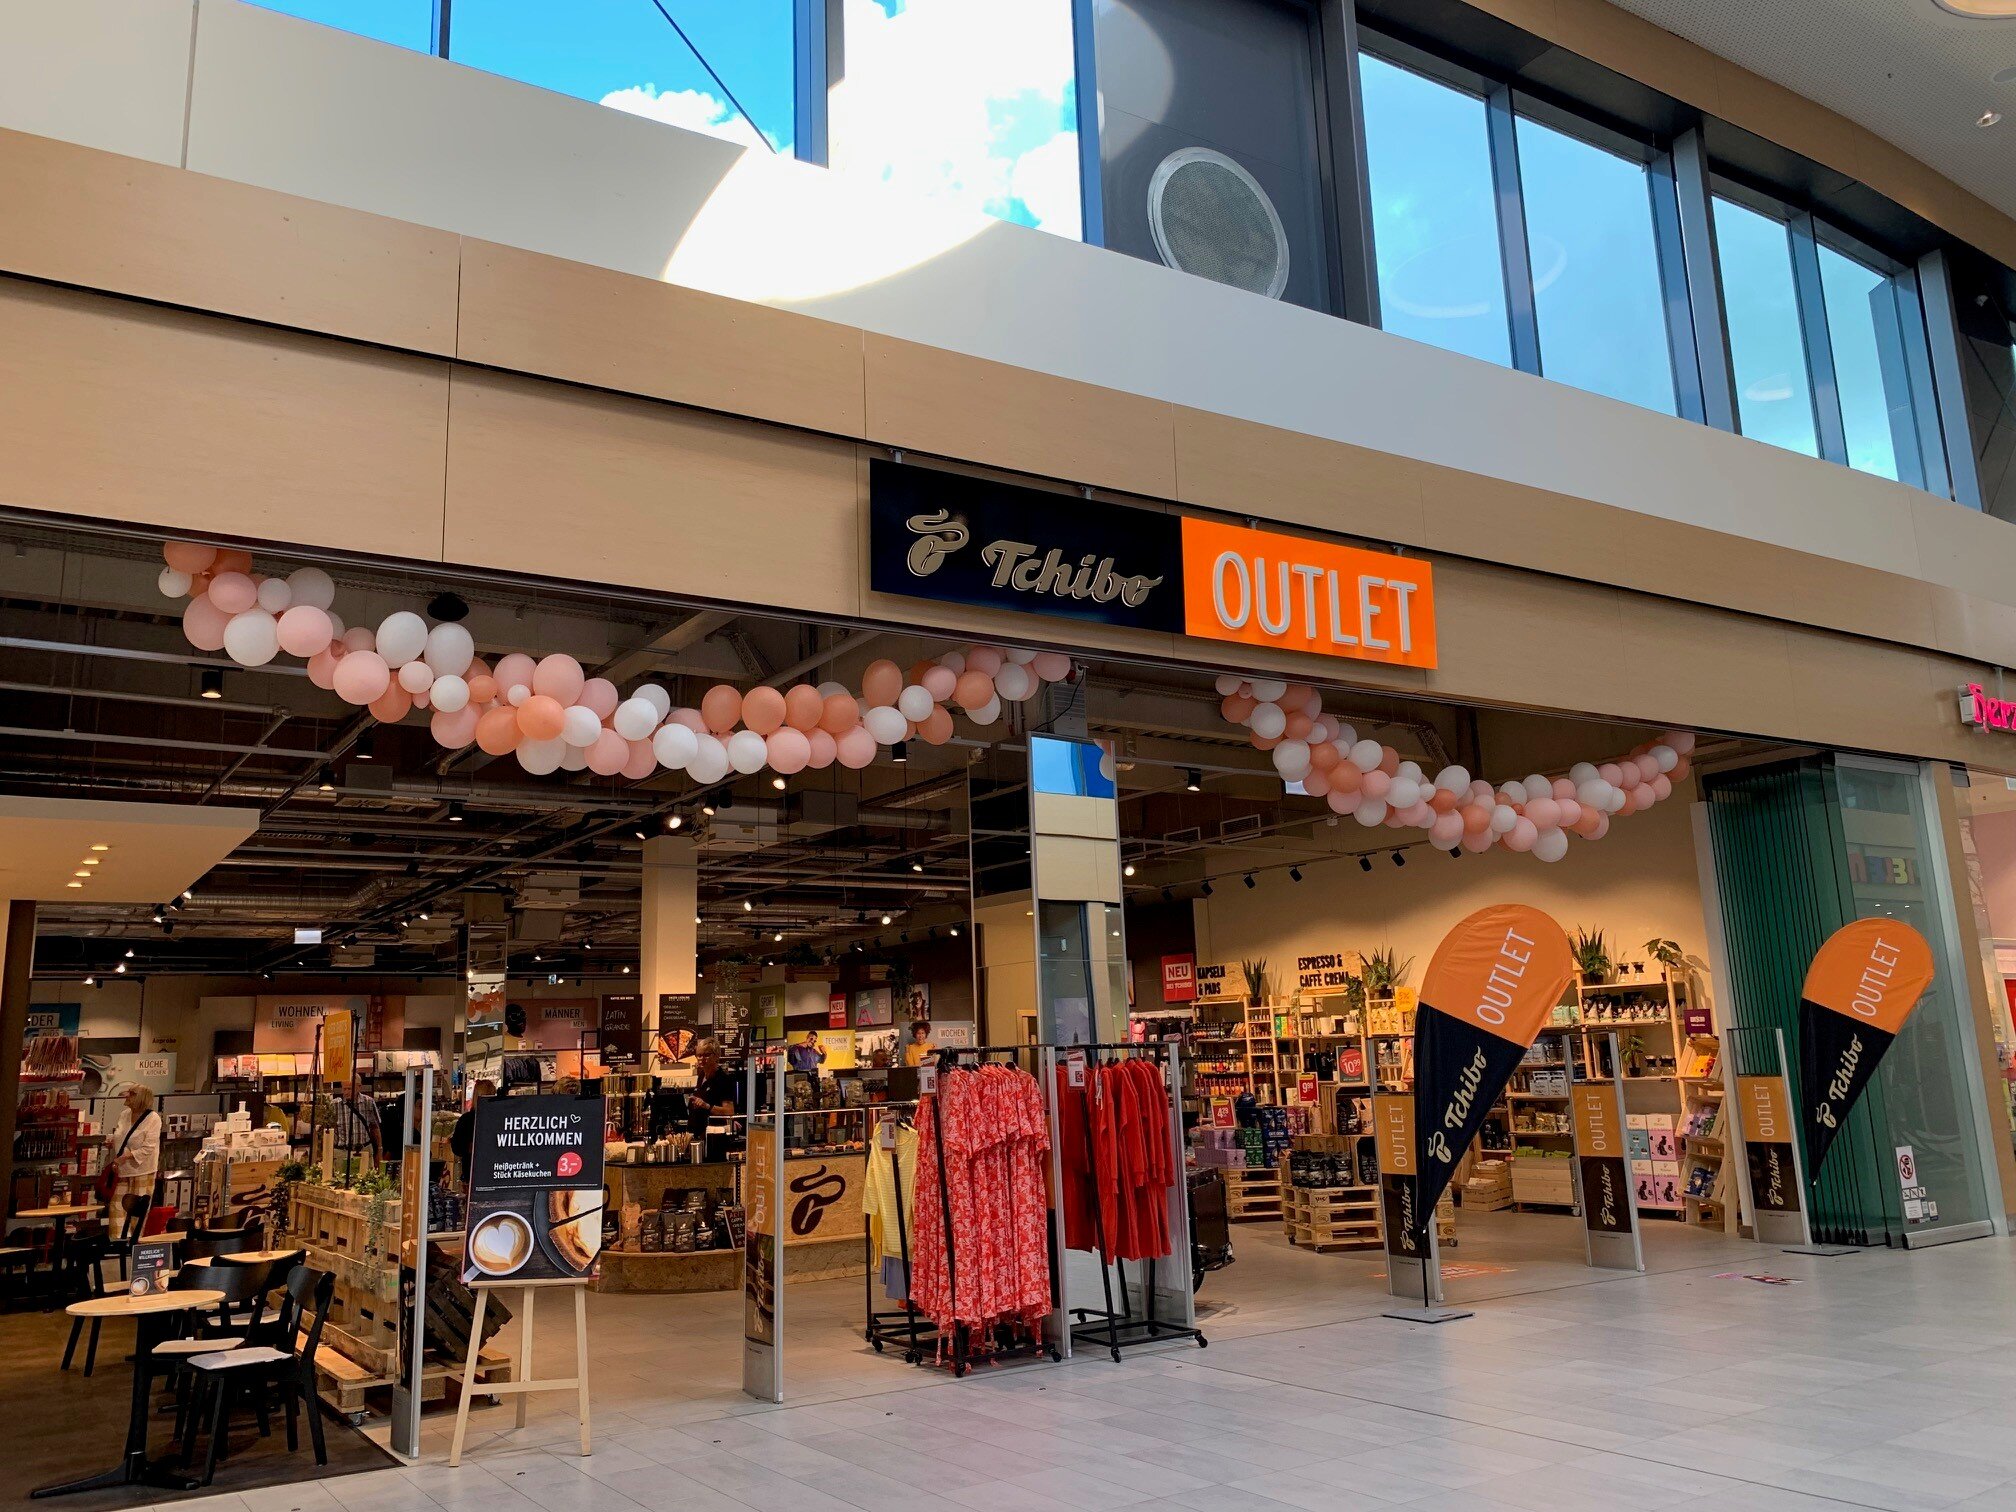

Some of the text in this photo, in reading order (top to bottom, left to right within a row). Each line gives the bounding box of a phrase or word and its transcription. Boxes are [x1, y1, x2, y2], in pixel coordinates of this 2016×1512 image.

[981, 540, 1163, 607] Tchibo
[1212, 550, 1418, 653] OUTLET
[1298, 955, 1335, 970] ESPRESSO
[1168, 966, 1188, 978] NEU
[1197, 965, 1226, 979] KAPSELN
[1300, 970, 1322, 987] CAFFÈ
[1475, 927, 1535, 1025] OUTLET
[1851, 937, 1901, 1017] OUTLET
[1204, 982, 1221, 995] PADS
[279, 1006, 324, 1017] WOHNEN
[544, 1008, 580, 1018] MÄNNER
[272, 1020, 294, 1028] LIVING
[825, 1037, 848, 1045] TECHNIK
[940, 1029, 966, 1038] WOCHEN
[139, 1059, 164, 1068] KÜCHE
[1828, 1033, 1864, 1101] Tchibo
[1444, 1045, 1487, 1128] Tchibo
[1754, 1084, 1775, 1136] OUTLET
[504, 1115, 567, 1131] HERZLICH
[1586, 1093, 1607, 1150] OUTLET
[496, 1132, 582, 1147] WILLKOMMEN
[1388, 1105, 1408, 1167] OUTLET
[493, 1160, 534, 1171] Heißgetränk
[493, 1168, 552, 1179] Stück Käsekuchen
[1769, 1148, 1782, 1190] Tchibo
[1600, 1164, 1615, 1208] Tchibo
[1401, 1182, 1414, 1231] Tchibo
